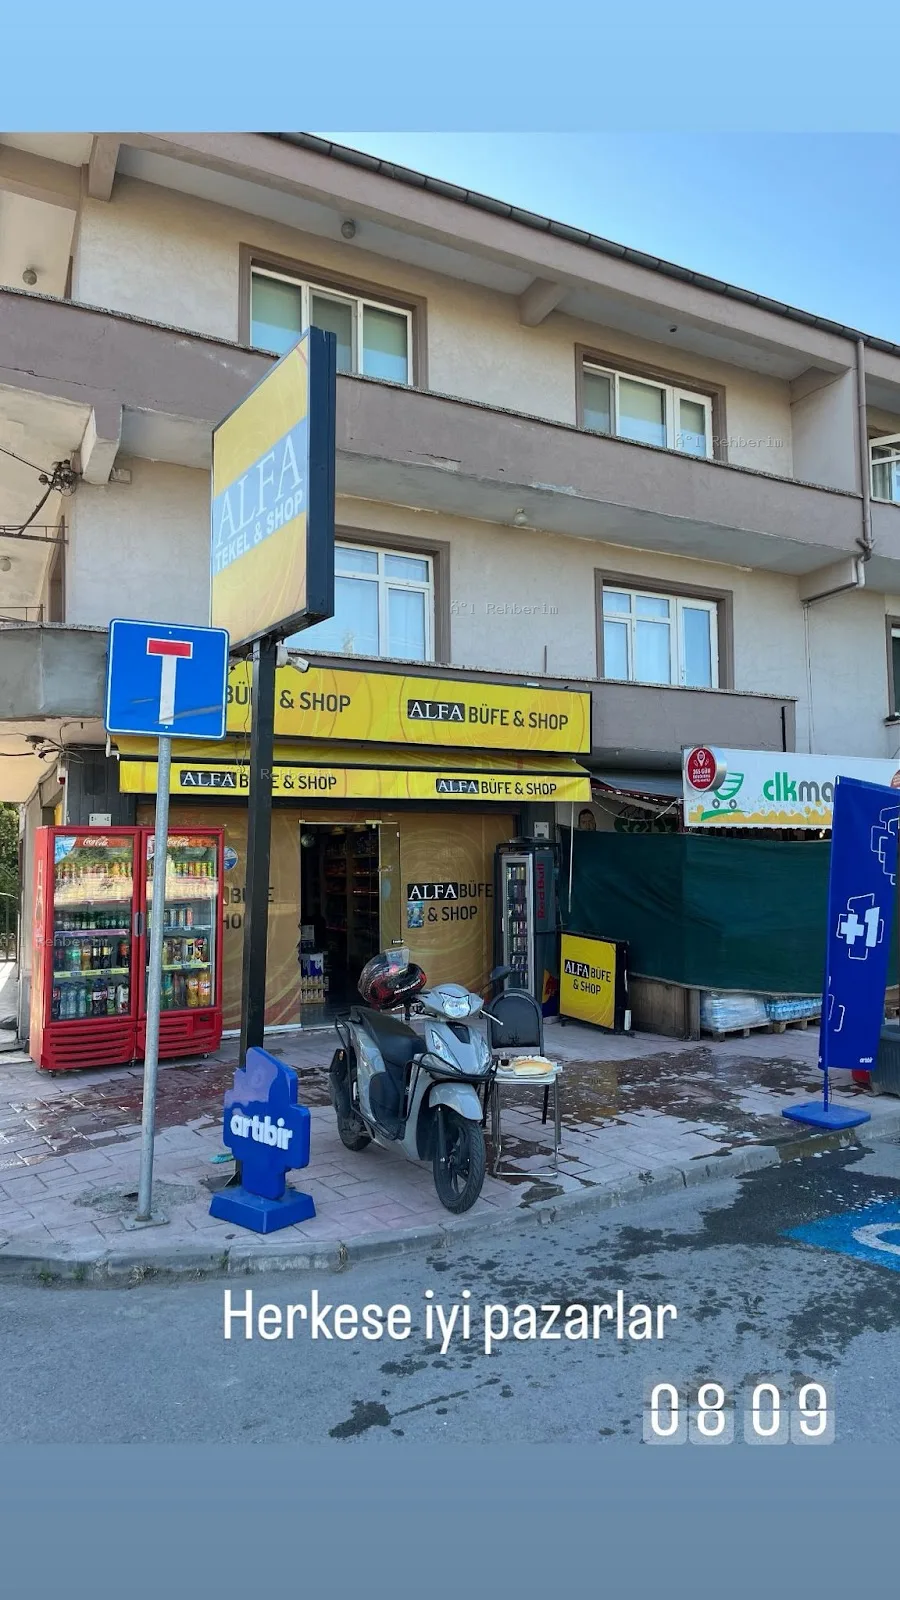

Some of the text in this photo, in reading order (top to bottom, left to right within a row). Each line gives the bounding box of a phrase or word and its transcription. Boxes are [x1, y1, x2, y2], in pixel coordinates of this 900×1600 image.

[215, 434, 303, 548] ALFA
[215, 489, 303, 572] TEKEL & SHOP
[226, 681, 351, 713] BÜ & SHOP
[409, 701, 569, 730] ALFA BÜFE & SHOP
[181, 772, 337, 790] ALFA BE & SHOP
[437, 778, 557, 795] ALFA BÜFE & SHOP
[763, 771, 834, 802] clkma
[231, 887, 274, 904] BE
[408, 880, 493, 900] ALFA BÜFE
[428, 907, 438, 922] &
[442, 906, 477, 921] SHOP
[840, 906, 880, 947] +1
[565, 960, 611, 983] ALFA BÜFE
[573, 979, 601, 995] & SHOP
